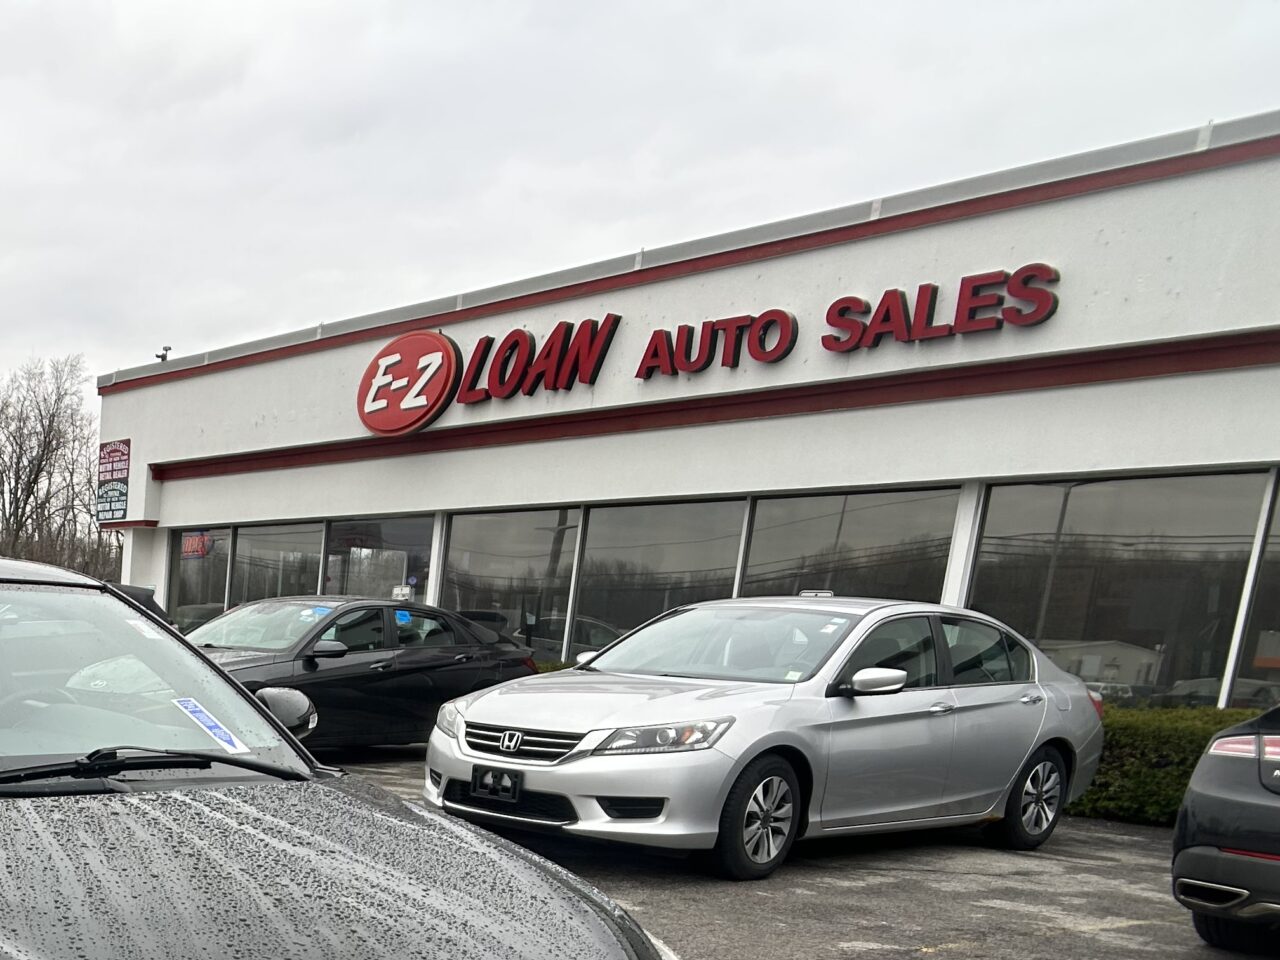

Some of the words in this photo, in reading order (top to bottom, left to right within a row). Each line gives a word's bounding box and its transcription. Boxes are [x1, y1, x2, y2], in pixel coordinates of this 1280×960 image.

[363, 352, 446, 415] E-Z
[455, 313, 622, 405] LOAN
[634, 309, 798, 379] AUTO
[821, 263, 1060, 353] SALES
